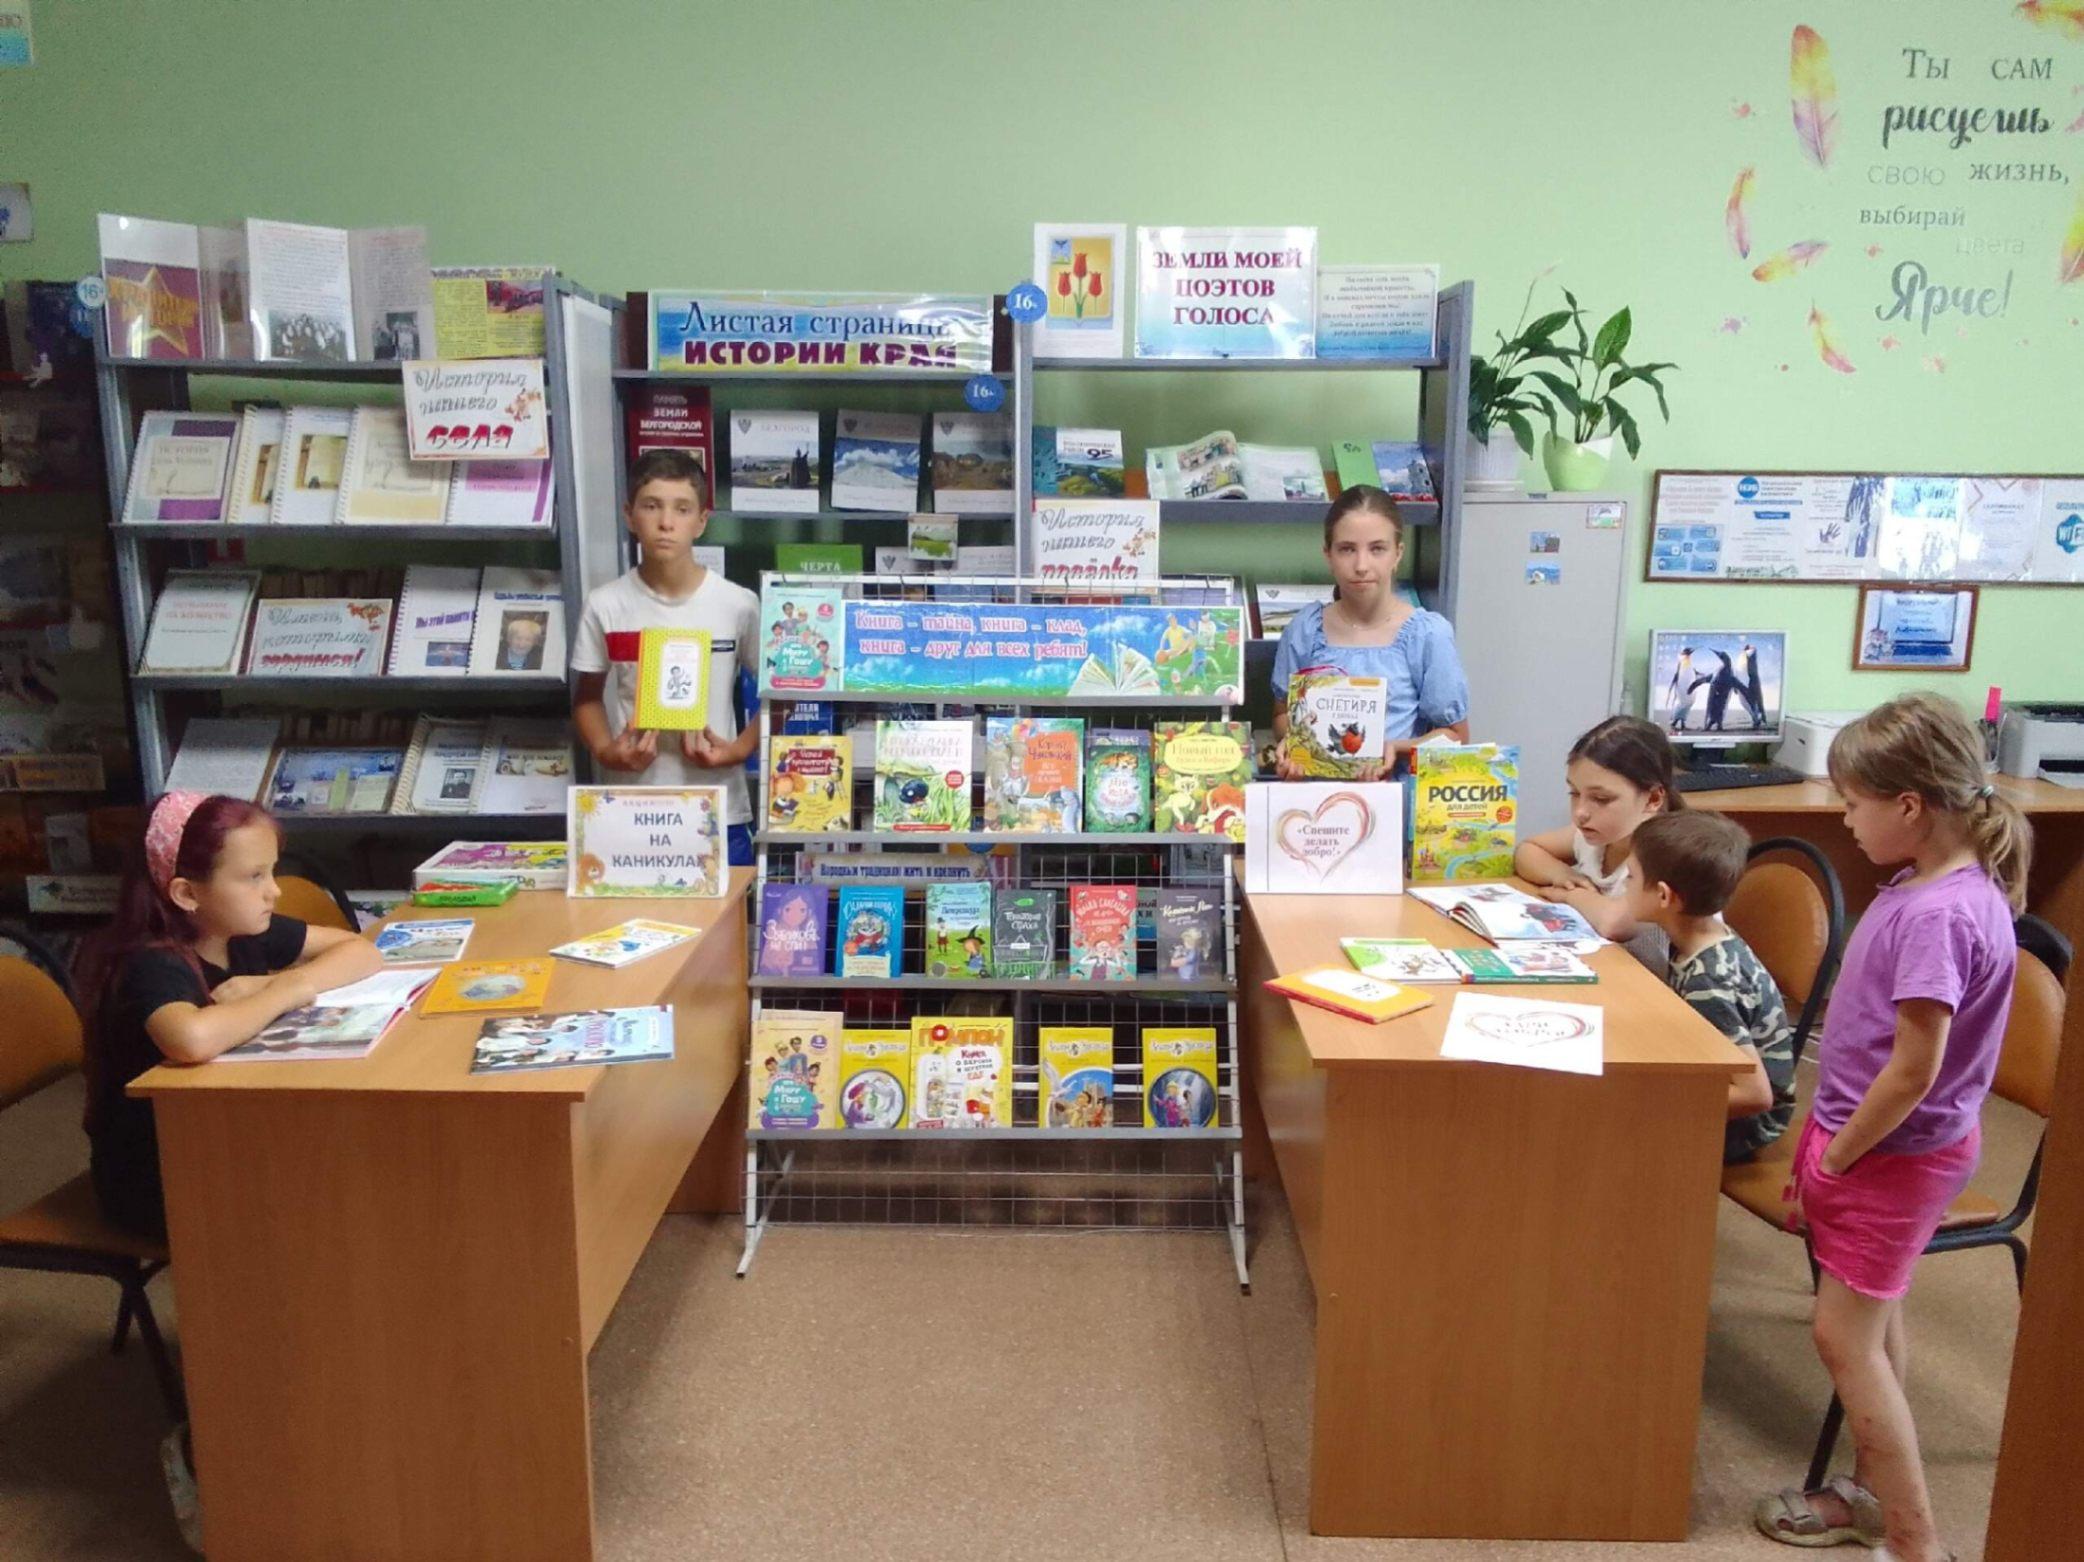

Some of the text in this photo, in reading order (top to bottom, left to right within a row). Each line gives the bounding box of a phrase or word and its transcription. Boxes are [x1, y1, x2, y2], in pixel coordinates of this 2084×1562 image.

[1902, 48, 1950, 79] Ты
[1882, 104, 2053, 150] рисуешь
[1969, 162, 2070, 185] жизнь,
[1859, 205, 1966, 231] выбирай
[1153, 247, 1303, 269] ЗЕМЛИ МОЕЙ
[1175, 278, 1276, 297] ПОЭТОВ
[1874, 260, 2014, 337] Ярче!
[679, 301, 793, 333] Листая
[1173, 306, 1275, 326] ГОЛОСА
[684, 341, 958, 368] ИСТОРИИ КРАЯ
[414, 368, 528, 394] История
[419, 398, 498, 416] нашего
[653, 407, 689, 418] ЗЕМЛИ
[640, 419, 702, 432] БЕЛГОРОДСКОЙ
[1041, 508, 1145, 533] История
[1041, 535, 1115, 553] нашего
[800, 560, 841, 573] ЧЕРТА
[856, 614, 903, 629] Книга
[922, 616, 976, 634] тайна,
[980, 618, 1026, 631] книга
[1046, 619, 1087, 635] клад,
[860, 640, 905, 653] книга
[924, 642, 960, 659] друг
[964, 643, 993, 657] для
[997, 643, 1030, 656] всех
[1034, 637, 1087, 660] ребят!
[1316, 697, 1377, 713] СНЕГИРЯ
[1428, 785, 1508, 802] РОССИЯ
[634, 813, 683, 826] КНИГА
[649, 834, 672, 847] НА
